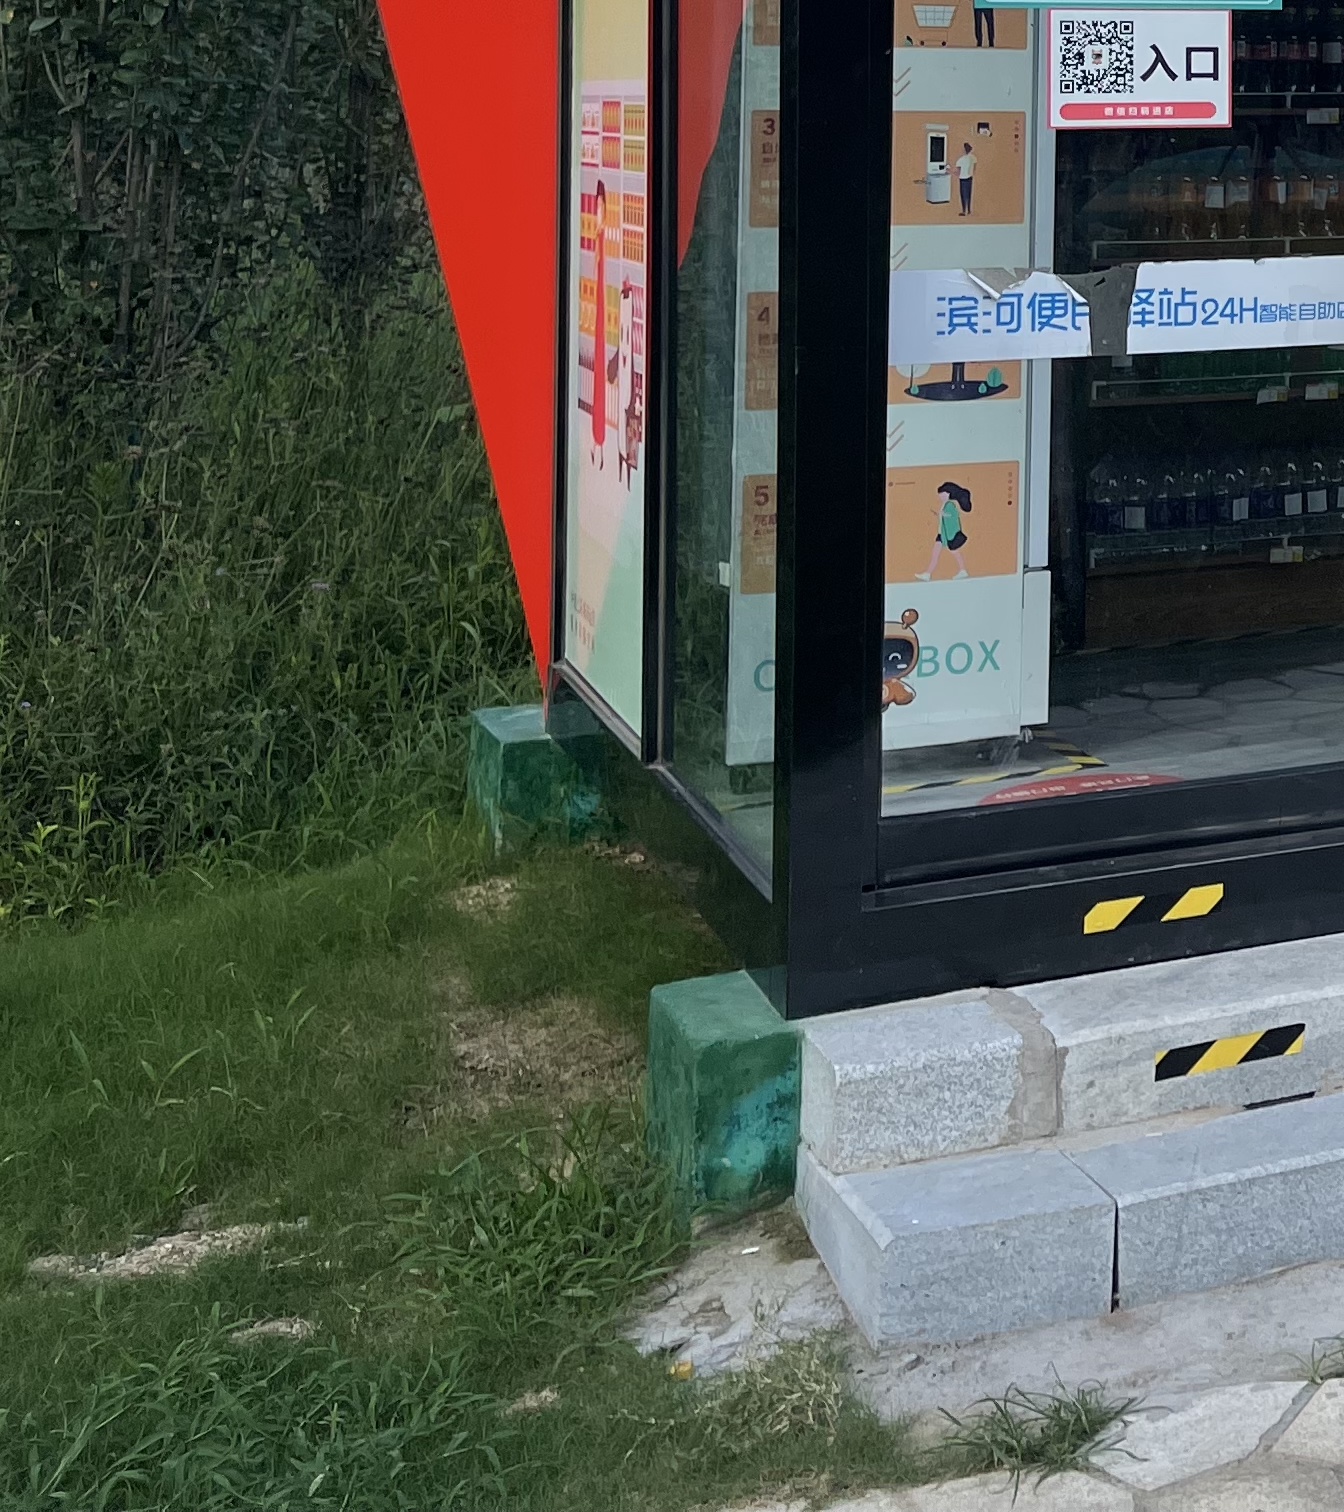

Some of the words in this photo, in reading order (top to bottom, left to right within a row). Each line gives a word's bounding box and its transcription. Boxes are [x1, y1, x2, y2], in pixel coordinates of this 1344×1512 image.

[1138, 43, 1220, 83] 入口
[1103, 104, 1175, 117] 微信扫码进店
[762, 117, 776, 136] 3
[753, 484, 770, 507] 5
